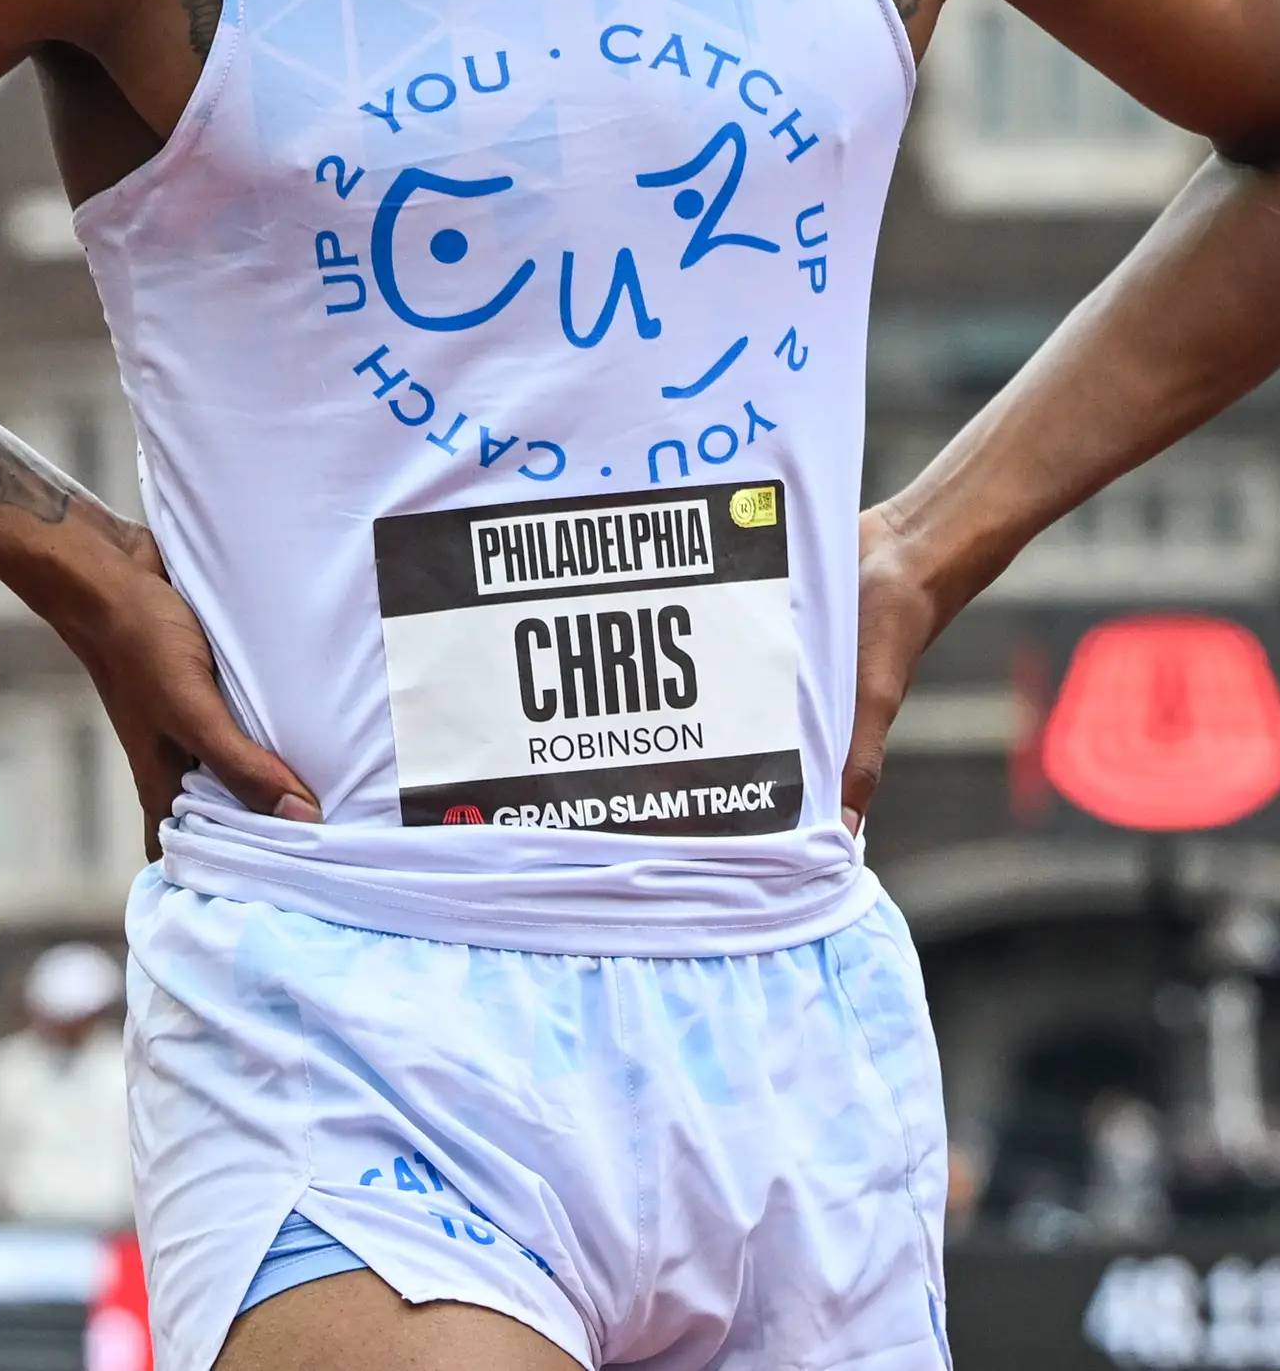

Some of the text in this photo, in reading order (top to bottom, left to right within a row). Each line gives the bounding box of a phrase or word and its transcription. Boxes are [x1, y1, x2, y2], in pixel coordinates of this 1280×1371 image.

[314, 50, 567, 483] CATCH UP 2 YOU
[599, 23, 829, 485] CATCH UP 2 YOU
[477, 507, 710, 586] PHILADELPHIA
[513, 604, 699, 724] CHRIS
[528, 722, 704, 765] ROBINSON
[492, 780, 776, 829] GRAND SLAM TRACK
